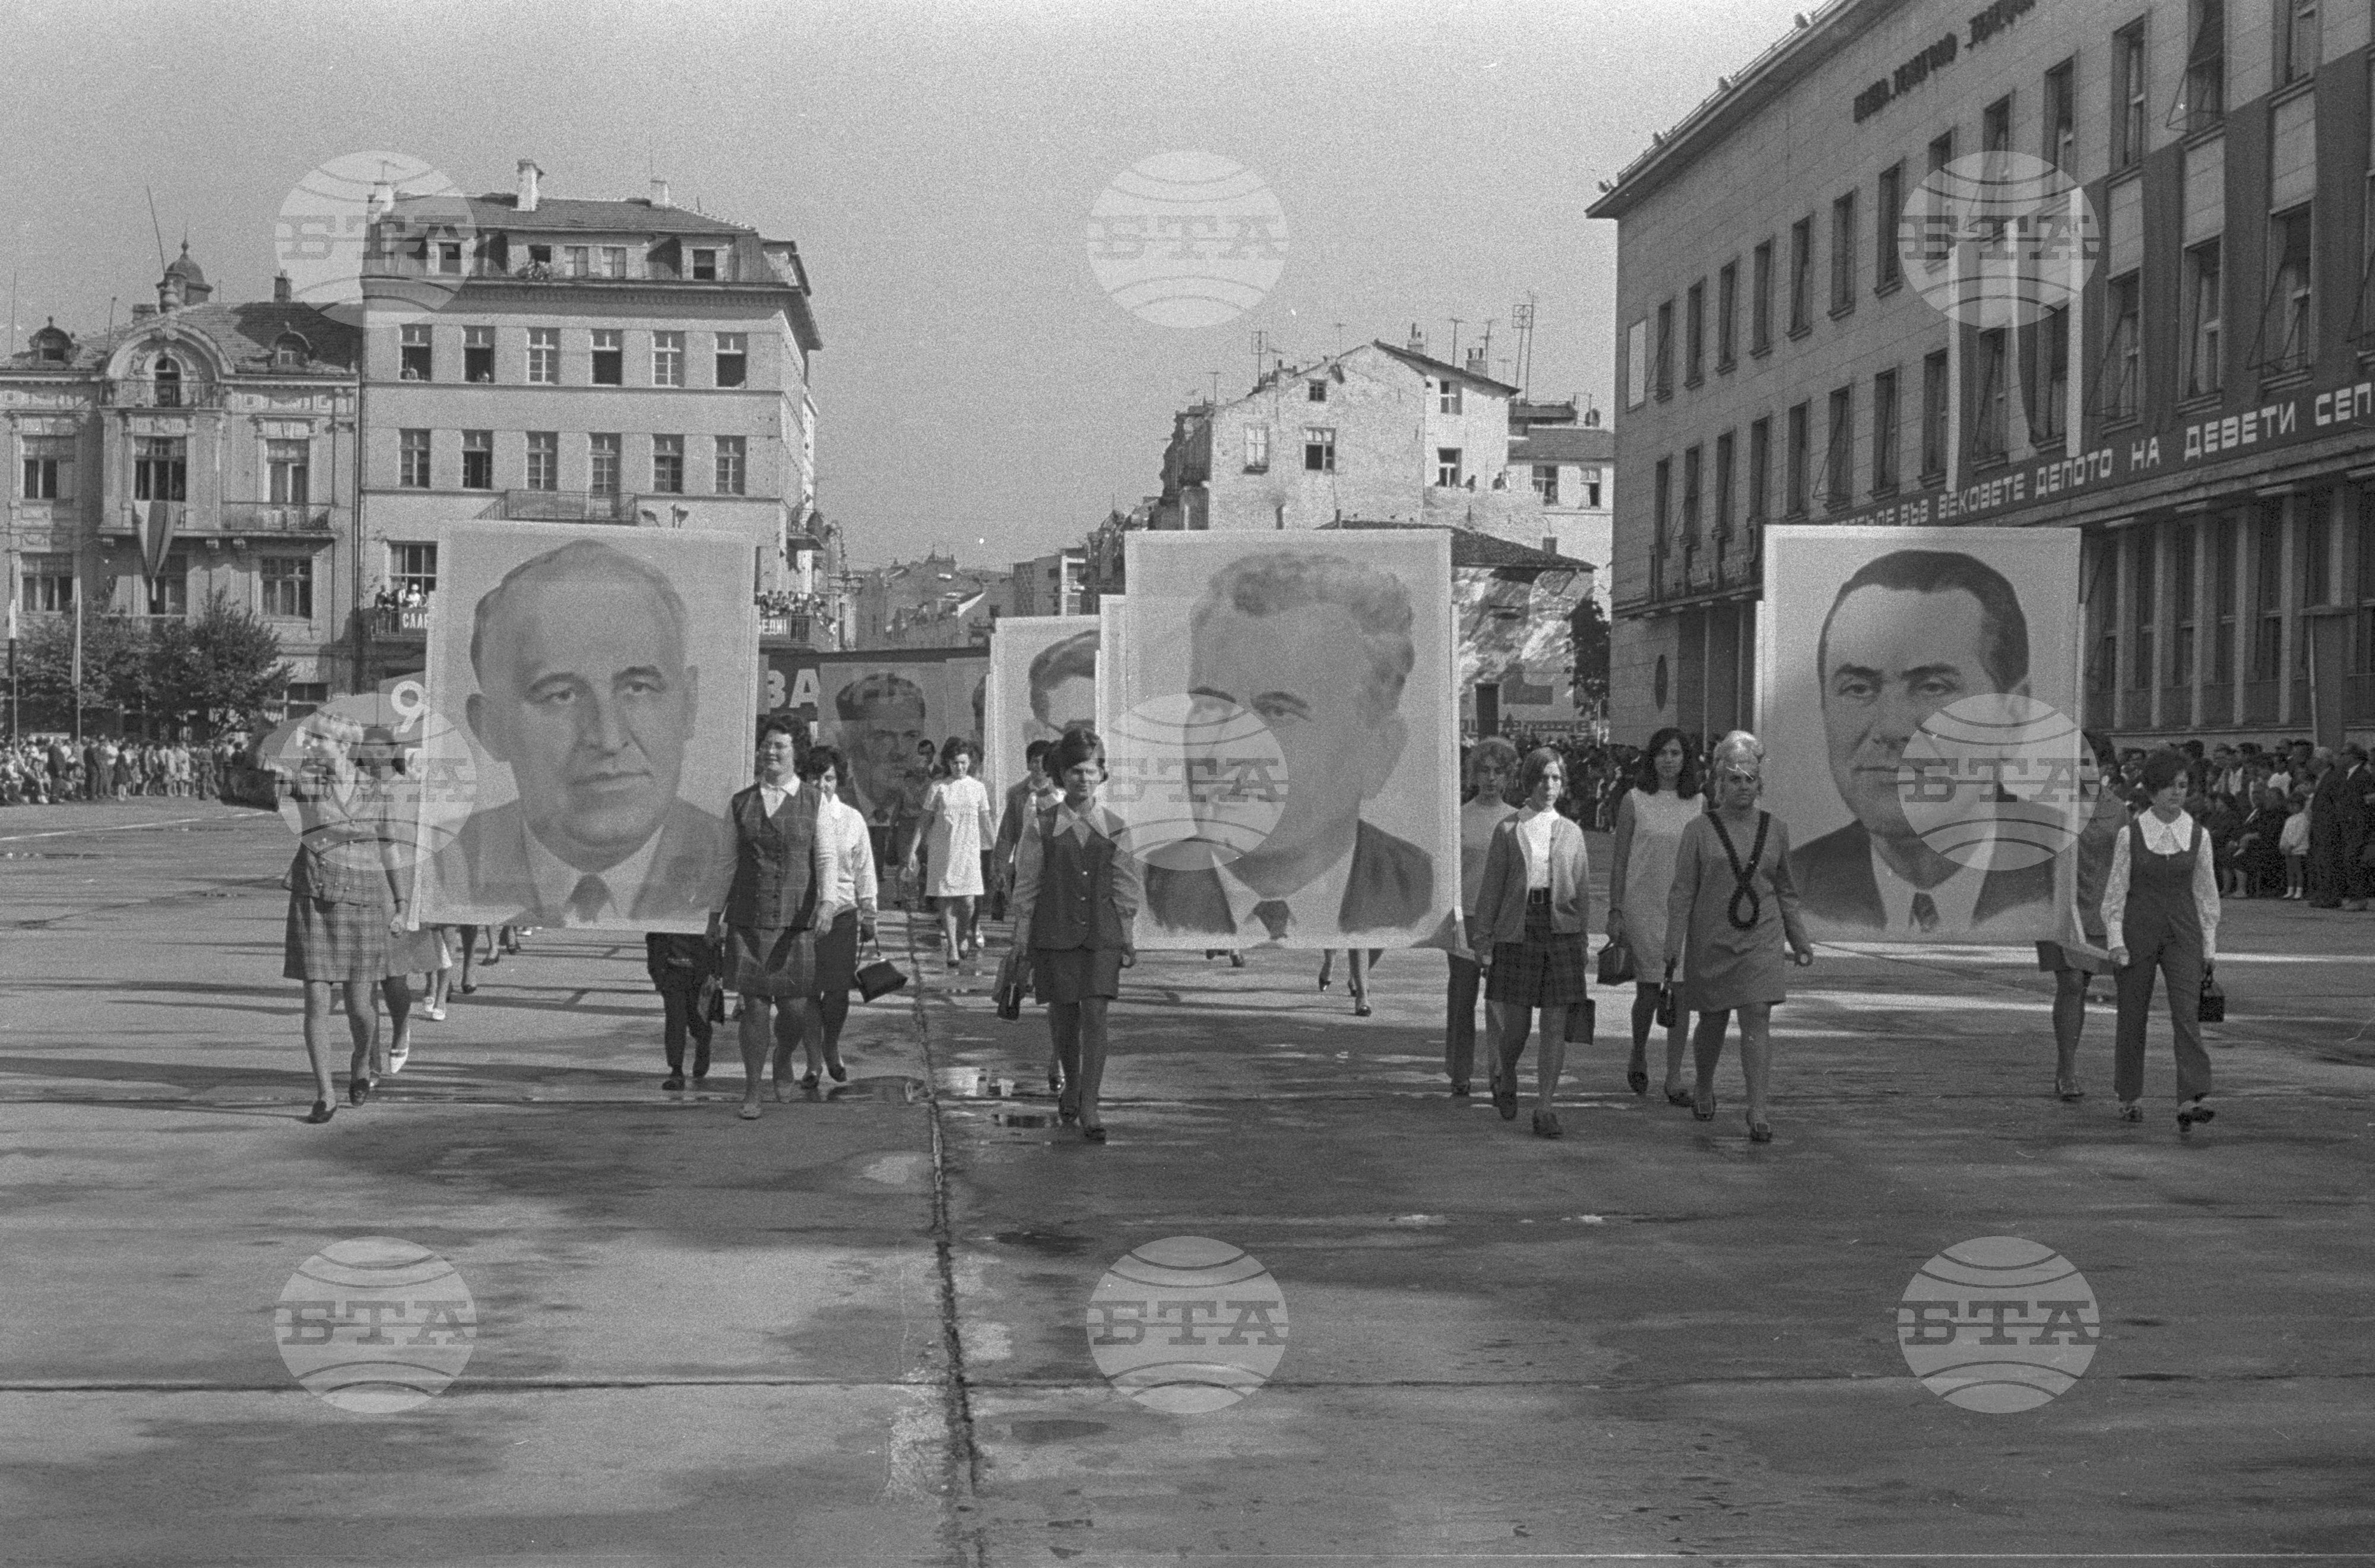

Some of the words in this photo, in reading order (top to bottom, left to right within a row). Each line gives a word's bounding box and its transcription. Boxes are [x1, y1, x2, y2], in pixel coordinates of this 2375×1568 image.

[1938, 473, 2025, 519] ВЕКОВЕТЕ
[2130, 436, 2161, 471] НА
[2184, 401, 2295, 461] ДЕВЕТИ
[2316, 382, 2375, 426] СЕП
